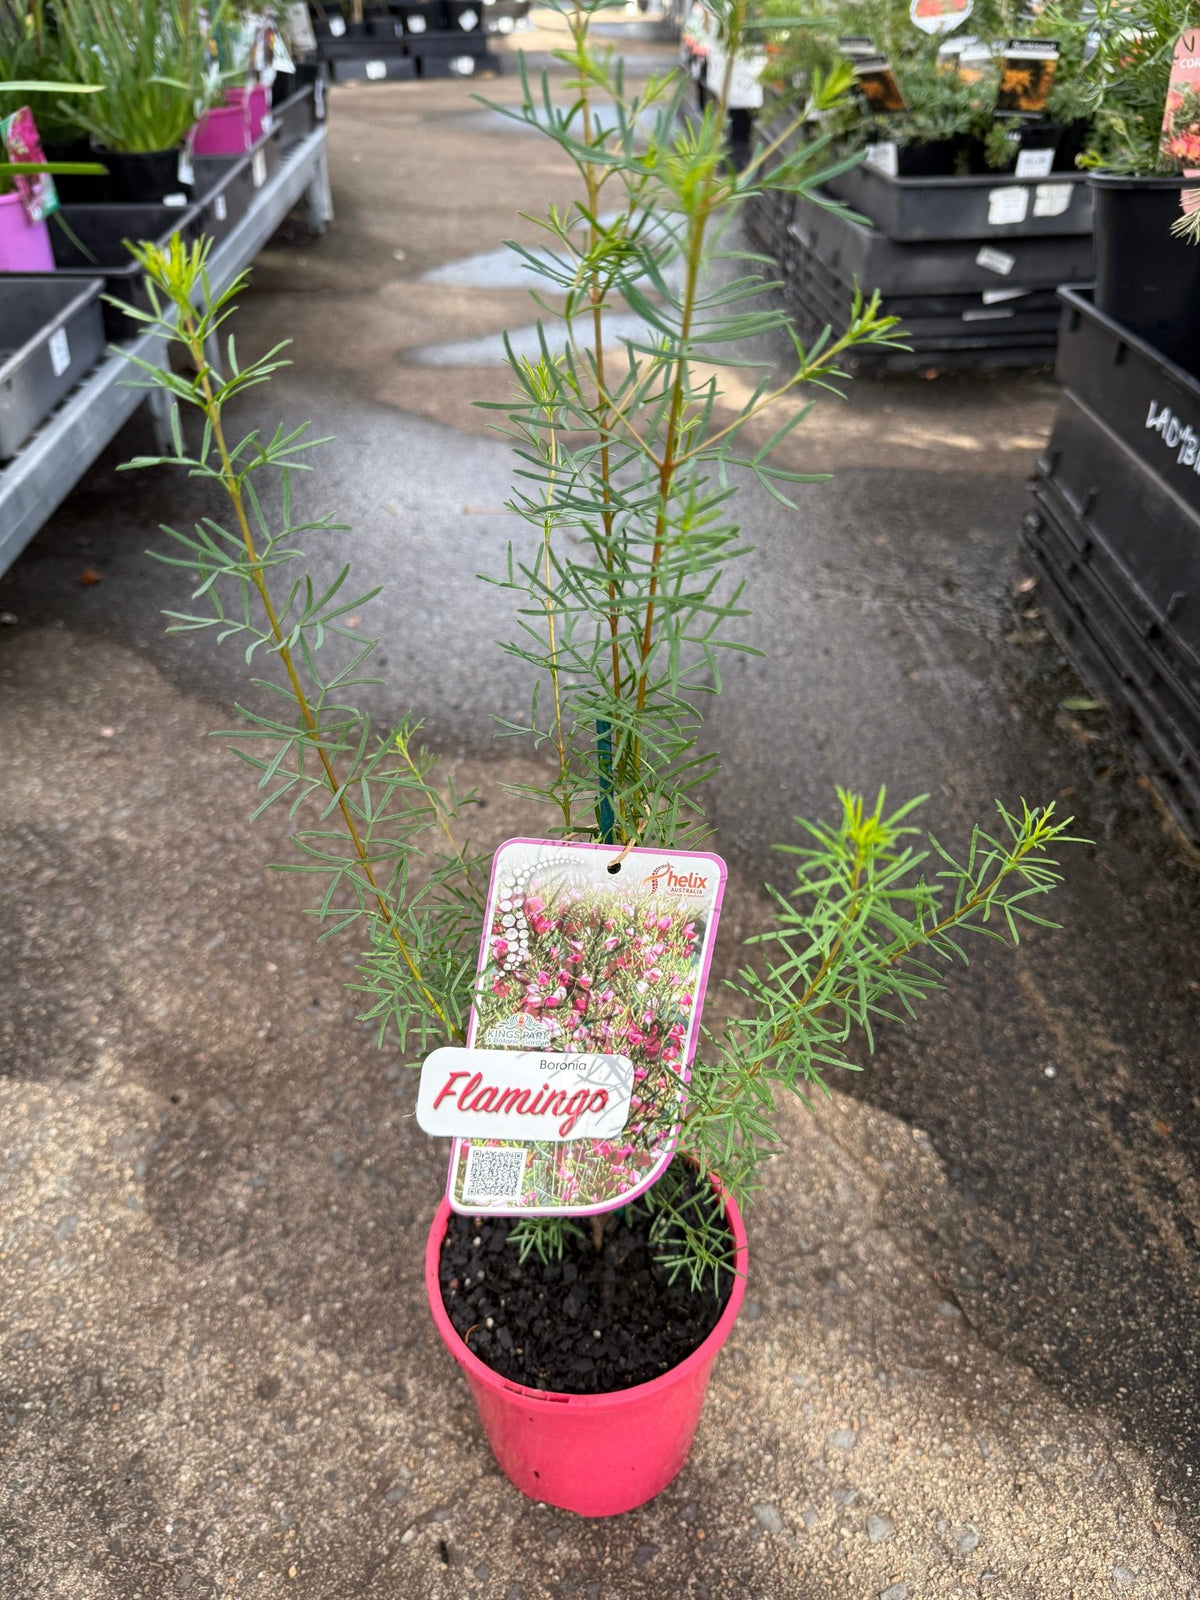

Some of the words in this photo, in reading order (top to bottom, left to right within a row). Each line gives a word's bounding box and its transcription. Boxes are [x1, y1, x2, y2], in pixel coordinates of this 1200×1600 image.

[667, 870, 708, 889] helix
[670, 887, 703, 895] AUSTRALIA
[487, 1030, 520, 1039] KINGS
[522, 1031, 550, 1040] PARK
[539, 1059, 587, 1071] Boronia
[432, 1071, 609, 1137] Flamingo
